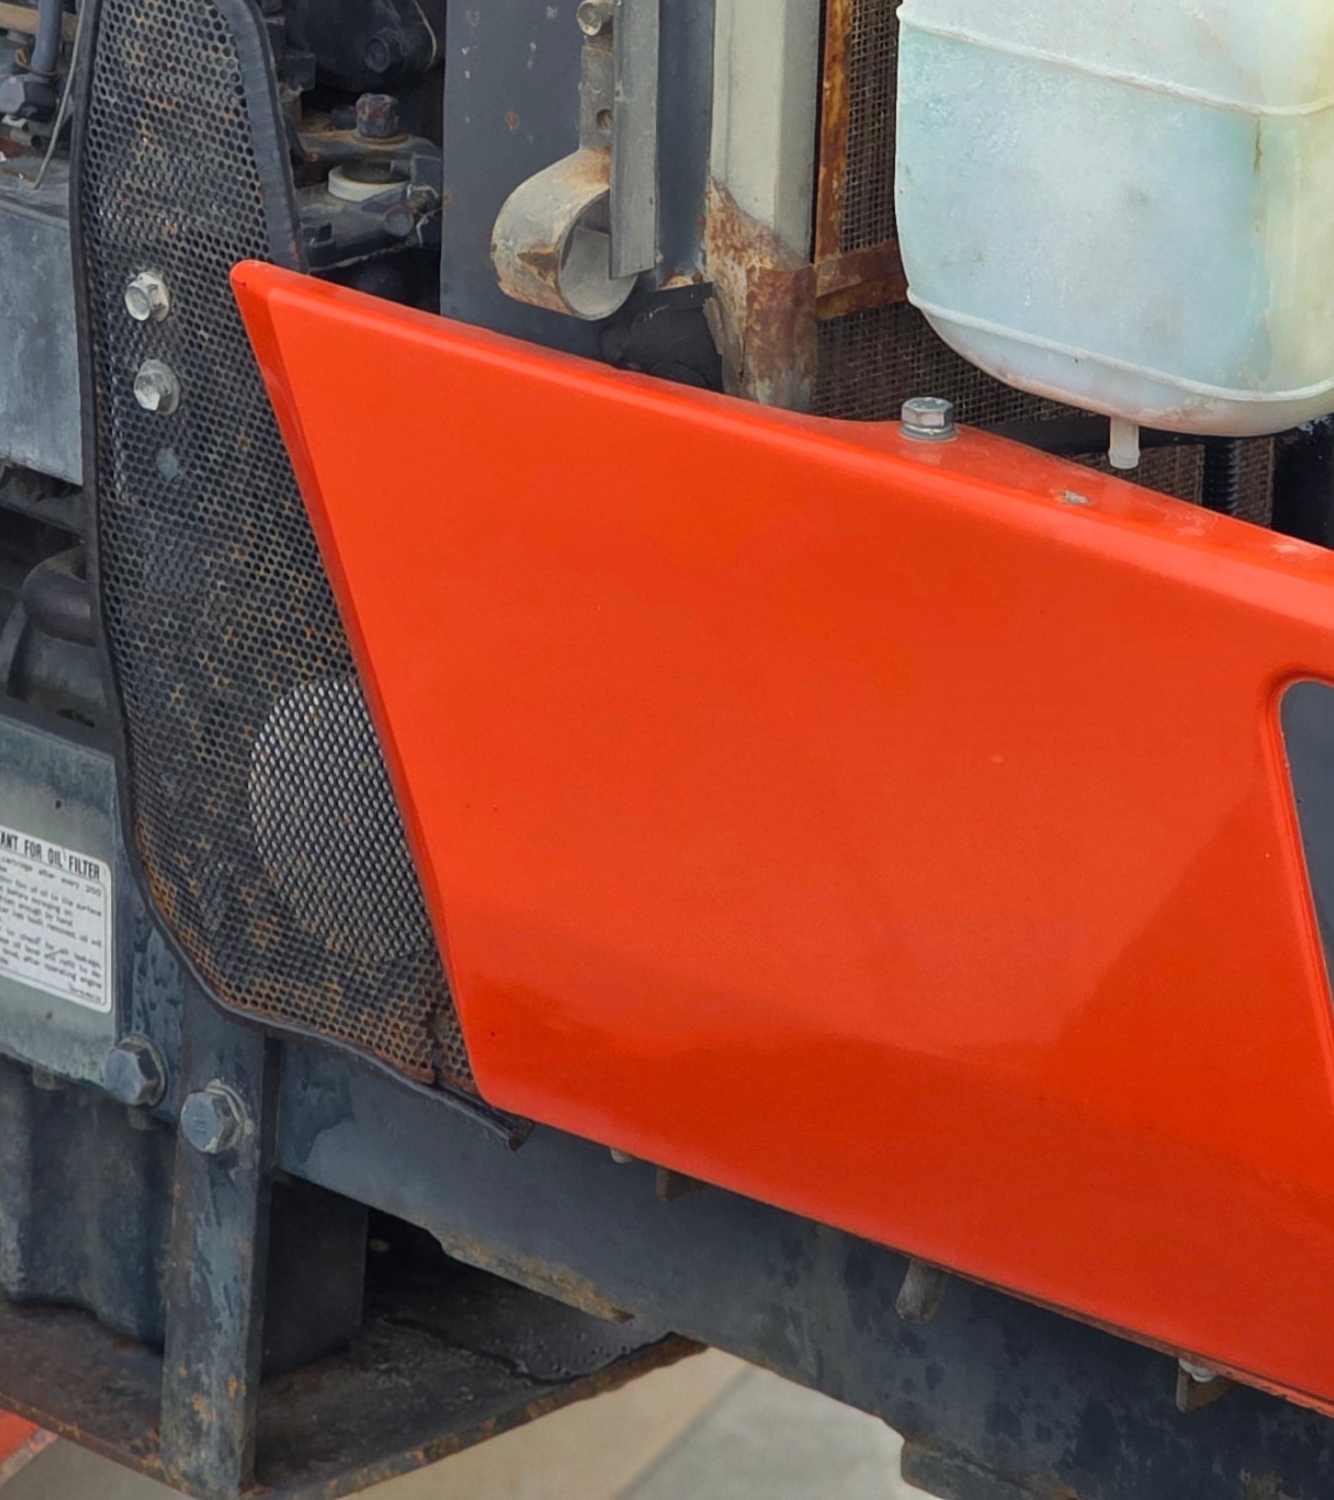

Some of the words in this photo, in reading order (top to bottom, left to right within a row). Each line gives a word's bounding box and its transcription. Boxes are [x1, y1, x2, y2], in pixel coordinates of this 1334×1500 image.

[25, 839, 42, 862] FOR
[48, 847, 62, 868] OIL
[69, 855, 100, 882] FILTER
